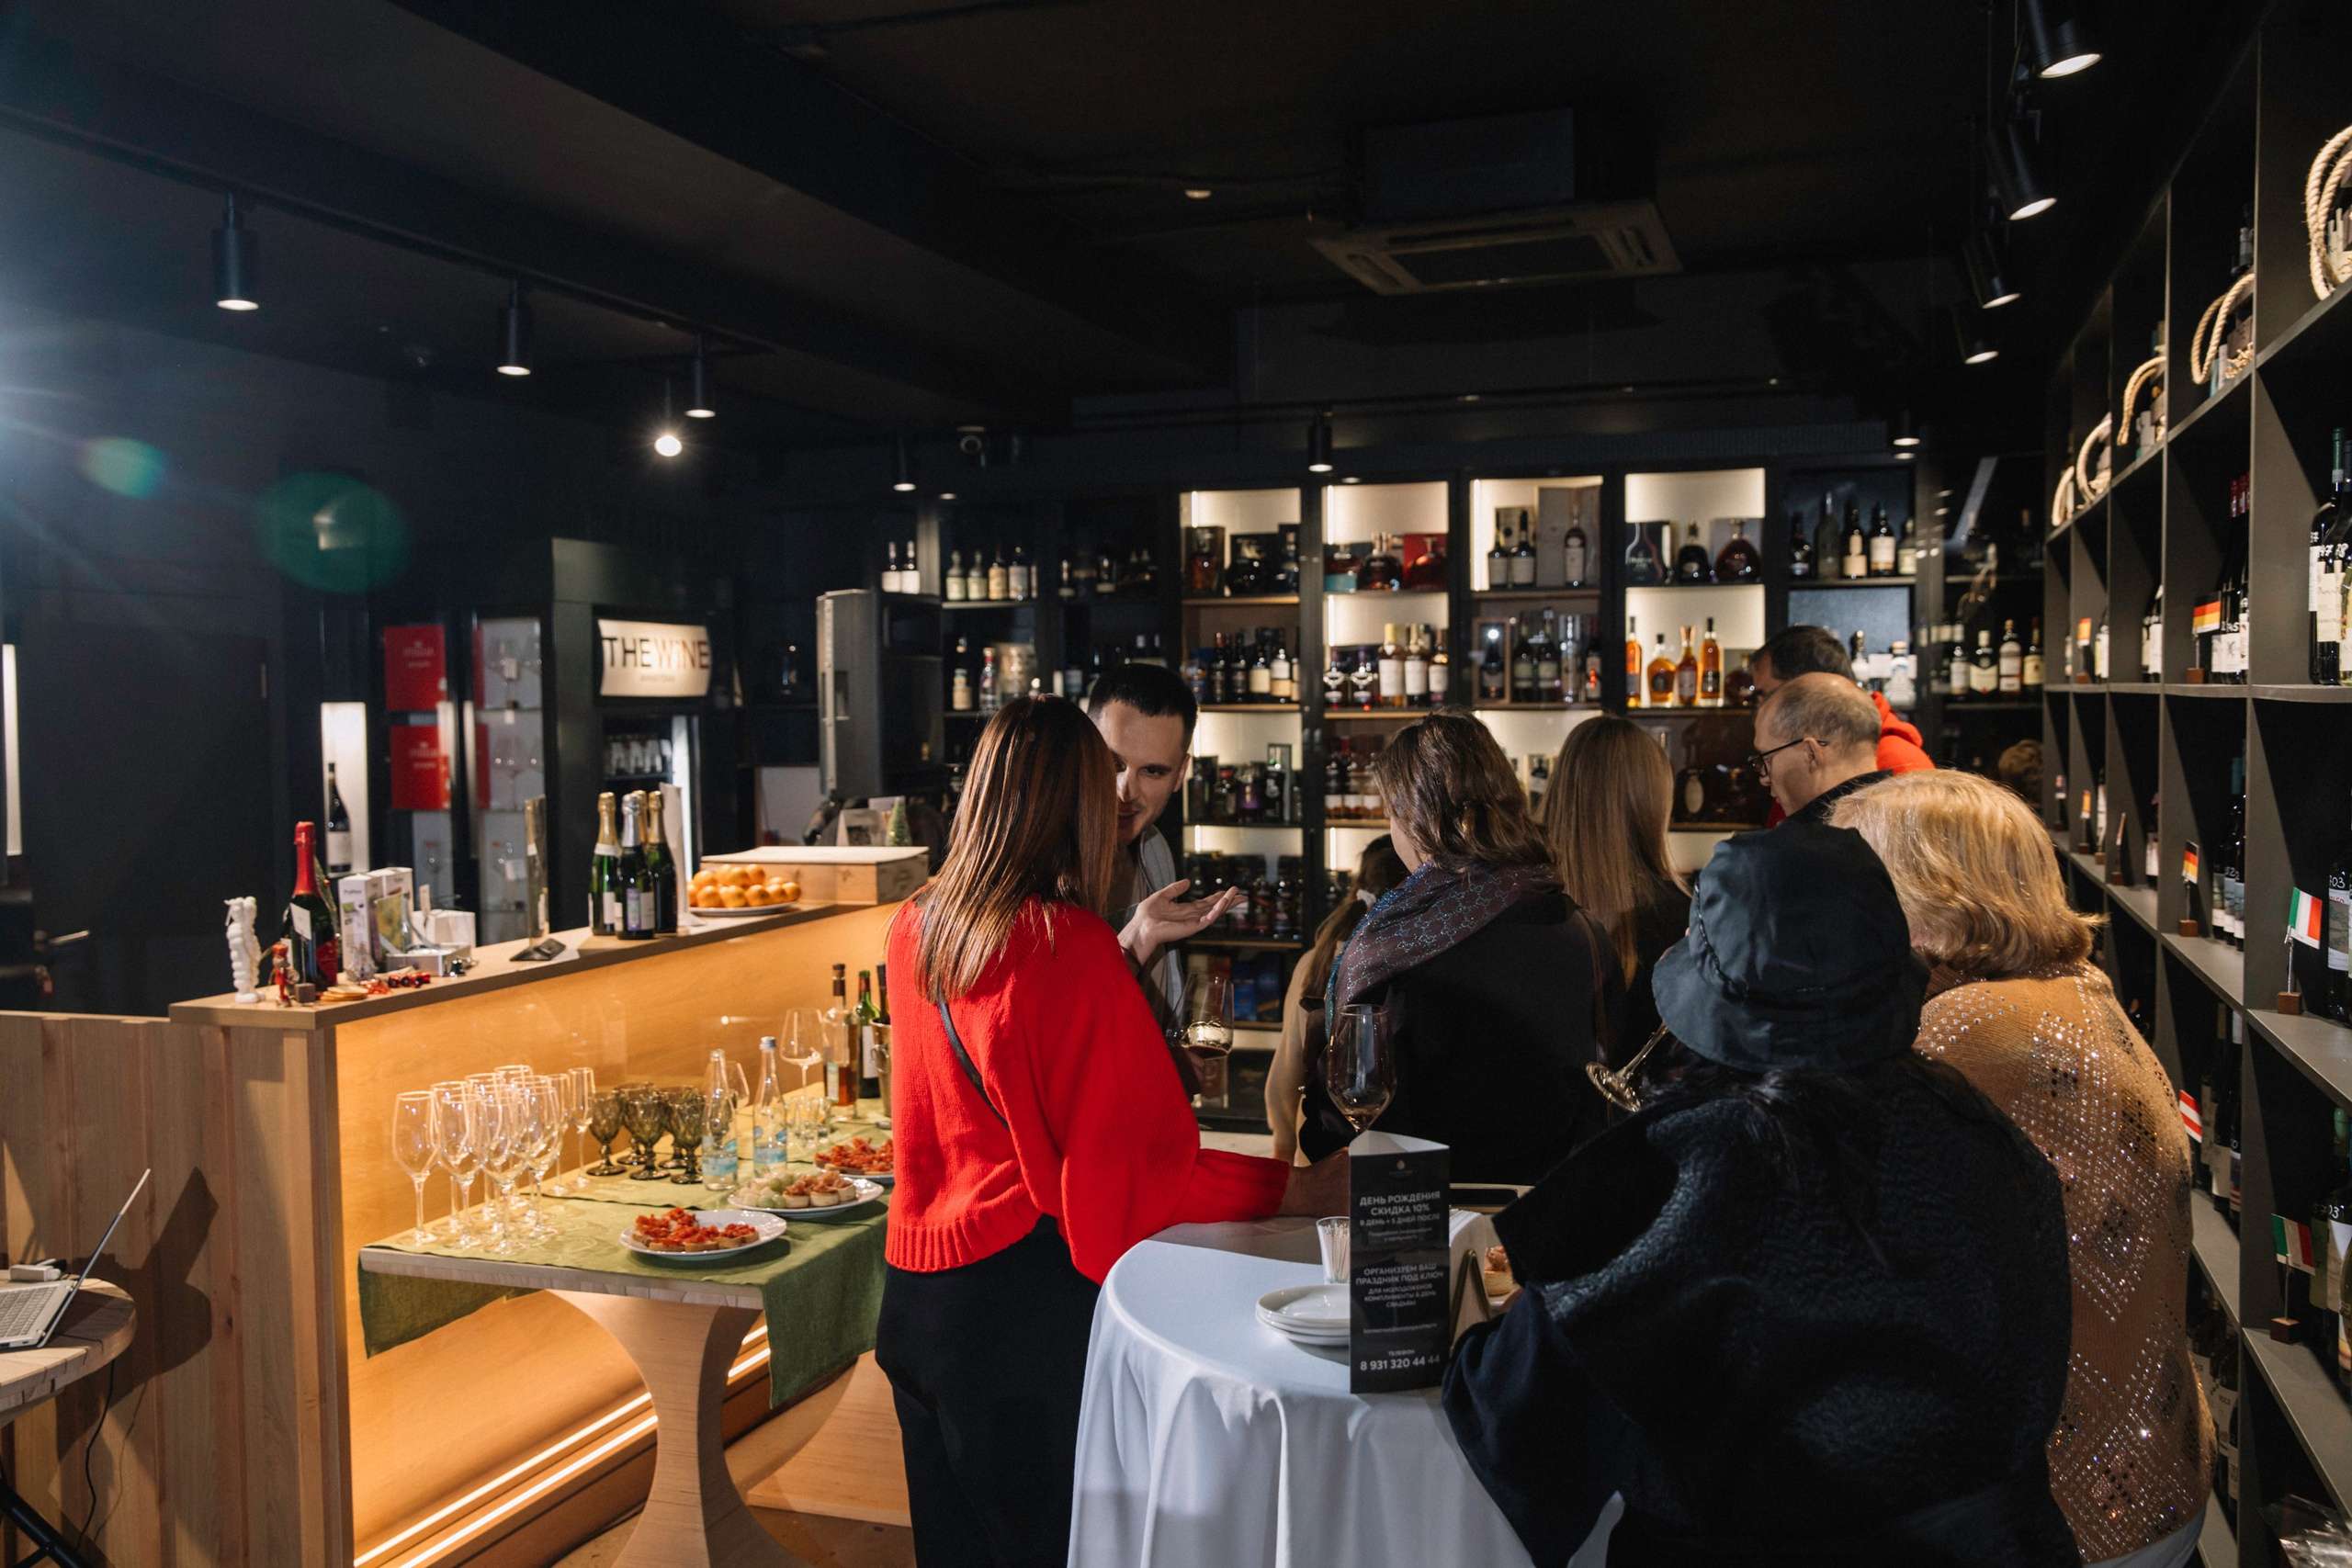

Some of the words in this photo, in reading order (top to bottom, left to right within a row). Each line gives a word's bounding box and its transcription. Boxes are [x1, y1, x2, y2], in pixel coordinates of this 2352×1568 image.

[602, 637, 651, 668] THE
[1359, 1196, 1386, 1207] ДЕНЬ
[1387, 1190, 1441, 1204] РОЖДЕНИЯ
[1370, 1204, 1411, 1216] СКИДКА
[1412, 1202, 1430, 1213] 10%
[1365, 1218, 1385, 1226] ДЕНЬ
[1396, 1214, 1416, 1224] ДНЕЙ
[1417, 1213, 1441, 1223] ПОСЛЕ
[1363, 1265, 1417, 1276] ОРГАНИЗУЕМ
[1418, 1262, 1437, 1271] ВАШ
[1355, 1274, 1400, 1285] ПРАЗДНИК
[1401, 1273, 1419, 1282] ПОД
[1419, 1270, 1443, 1280] КЛЮЧ
[1360, 1360, 1367, 1371] 8
[1369, 1359, 1388, 1371] 931
[1390, 1358, 1410, 1369] 320
[1412, 1356, 1426, 1367] 44
[1428, 1354, 1440, 1365] 44
